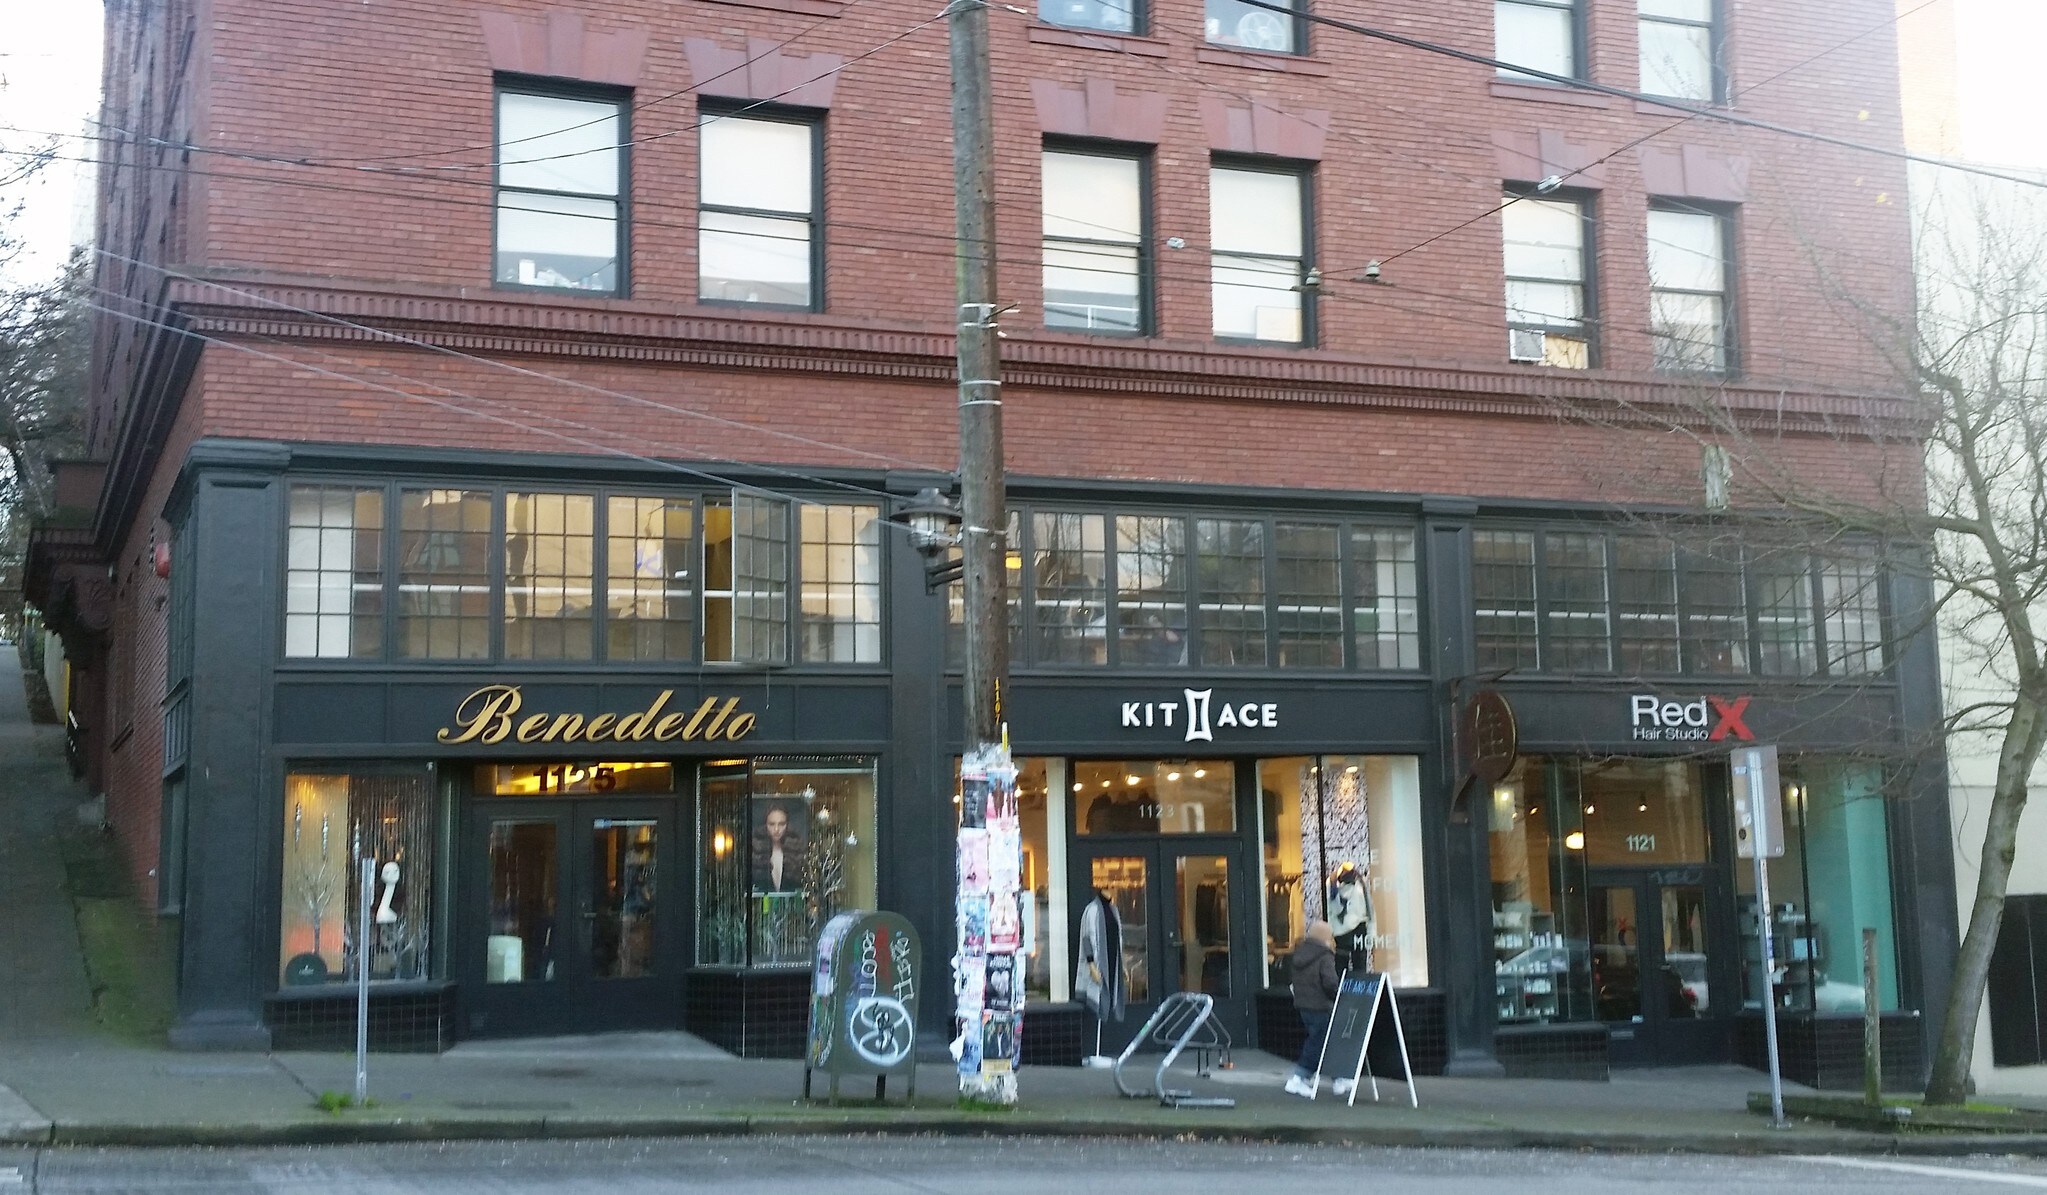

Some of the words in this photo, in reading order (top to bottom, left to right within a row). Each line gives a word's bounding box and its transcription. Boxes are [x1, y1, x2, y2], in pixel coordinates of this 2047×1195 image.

[437, 683, 757, 745] Benedetto
[1121, 702, 1179, 727] KIT
[1217, 703, 1278, 728] ACE
[1631, 694, 1709, 727] Red
[1708, 694, 1756, 741] X
[1632, 727, 1662, 741] Hair
[1665, 726, 1710, 742] Studio
[533, 765, 617, 793] 1125
[1138, 804, 1175, 819] 1123
[1626, 834, 1656, 852] 1121
